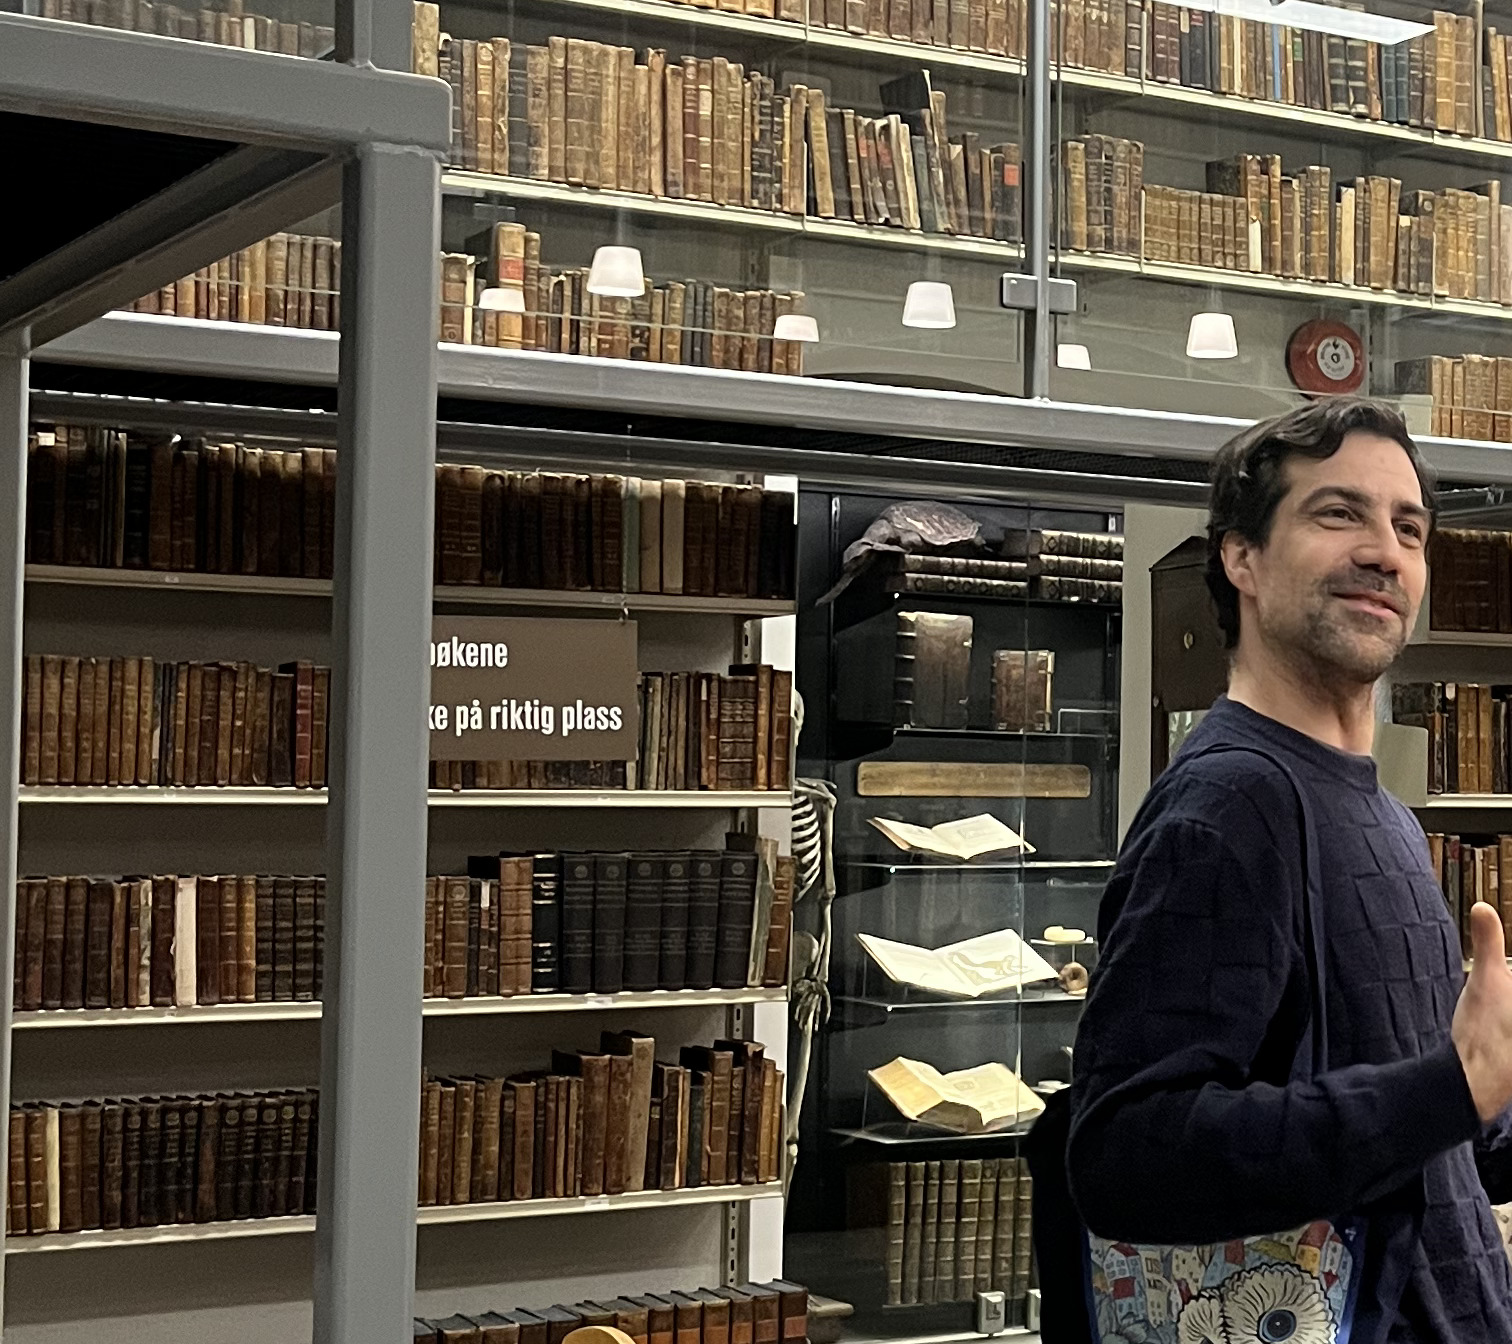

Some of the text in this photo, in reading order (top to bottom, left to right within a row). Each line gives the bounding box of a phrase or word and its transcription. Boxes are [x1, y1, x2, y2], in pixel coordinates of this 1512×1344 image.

[455, 699, 483, 737] på
[490, 698, 554, 735] riktig
[562, 699, 623, 737] plass
